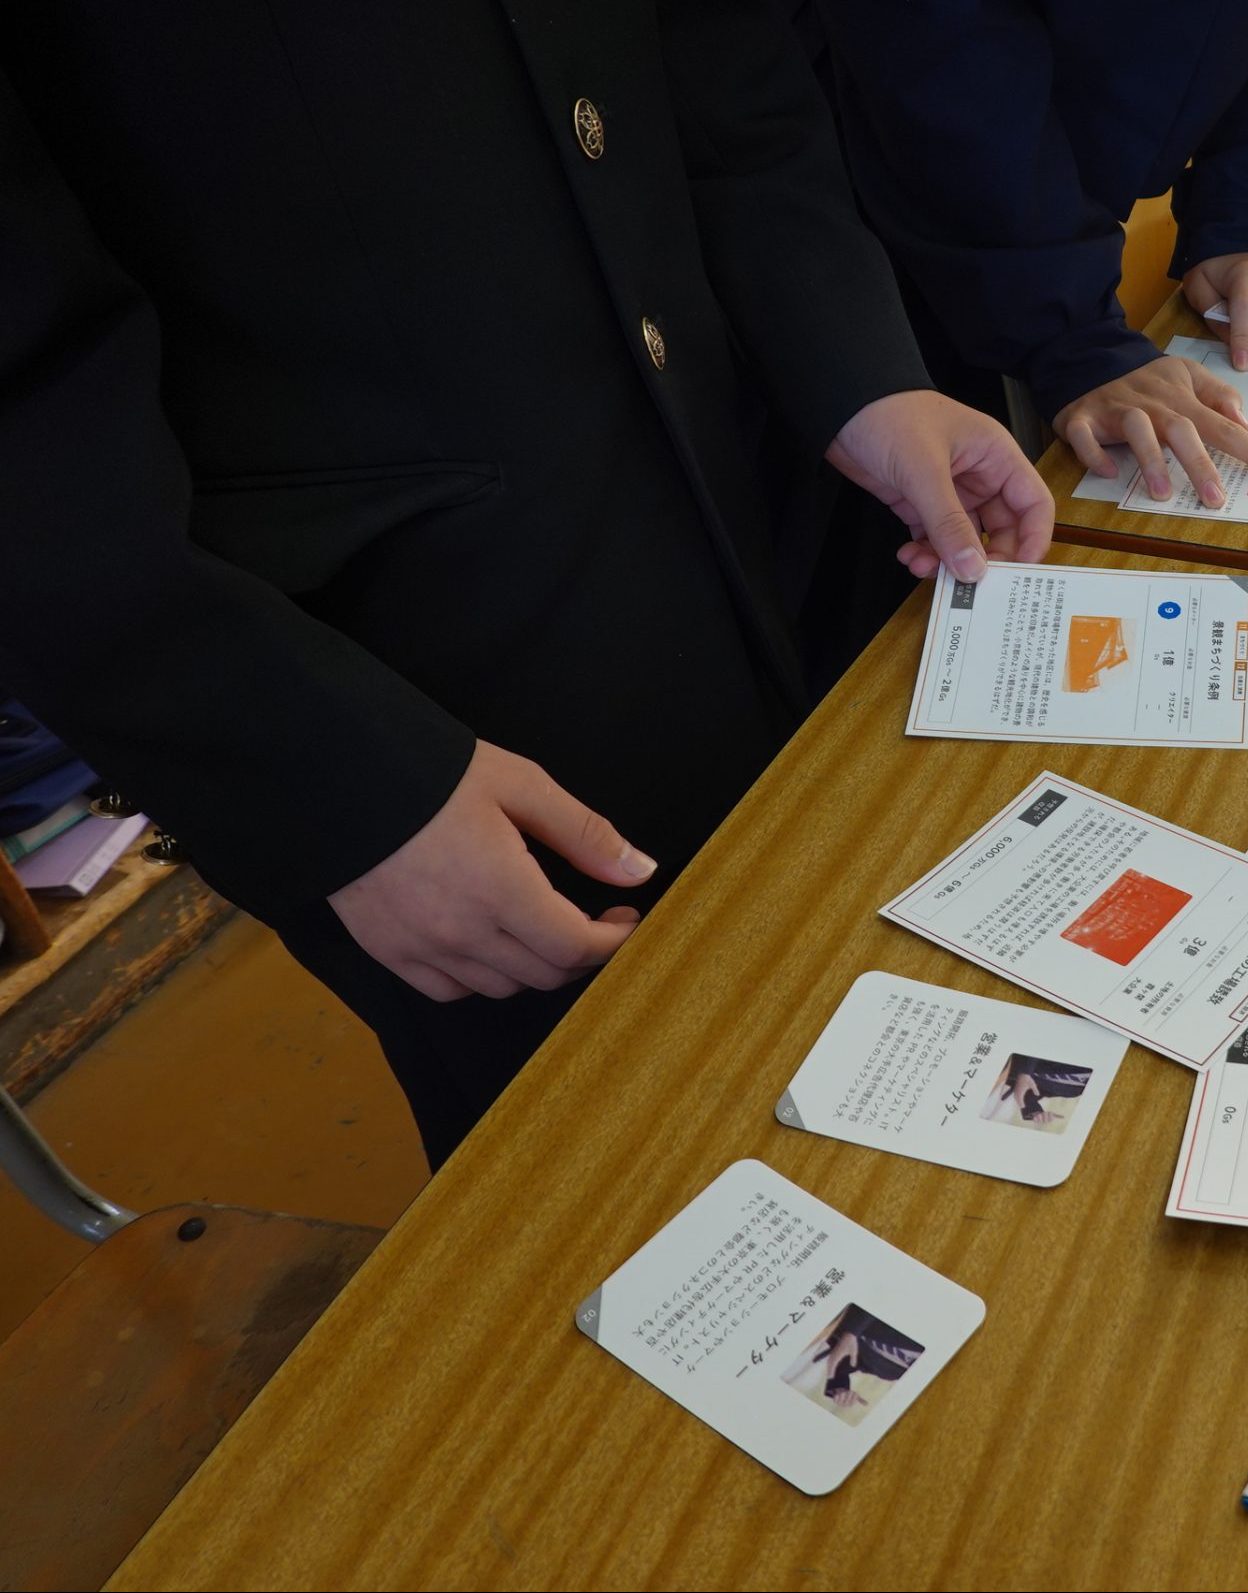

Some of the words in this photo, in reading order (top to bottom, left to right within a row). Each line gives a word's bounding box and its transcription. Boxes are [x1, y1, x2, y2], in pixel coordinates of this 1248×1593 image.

[1160, 649, 1174, 666] 1億
[1206, 619, 1224, 700] 景観まちづくり条例
[936, 679, 952, 701] 2億Gs
[1166, 690, 1176, 723] クリエイター
[966, 834, 1014, 872] 6,000万Gs
[931, 878, 964, 901] 6億Gs
[1180, 935, 1208, 958] 3億
[1120, 975, 1144, 995] 大企業
[1137, 979, 1175, 1015] 土地の所有者
[934, 1030, 998, 1128] 営業&マーケター
[1220, 1105, 1237, 1125] 0Gs
[738, 1191, 765, 1214] きい。
[729, 1265, 847, 1382] 営業&マーケター
